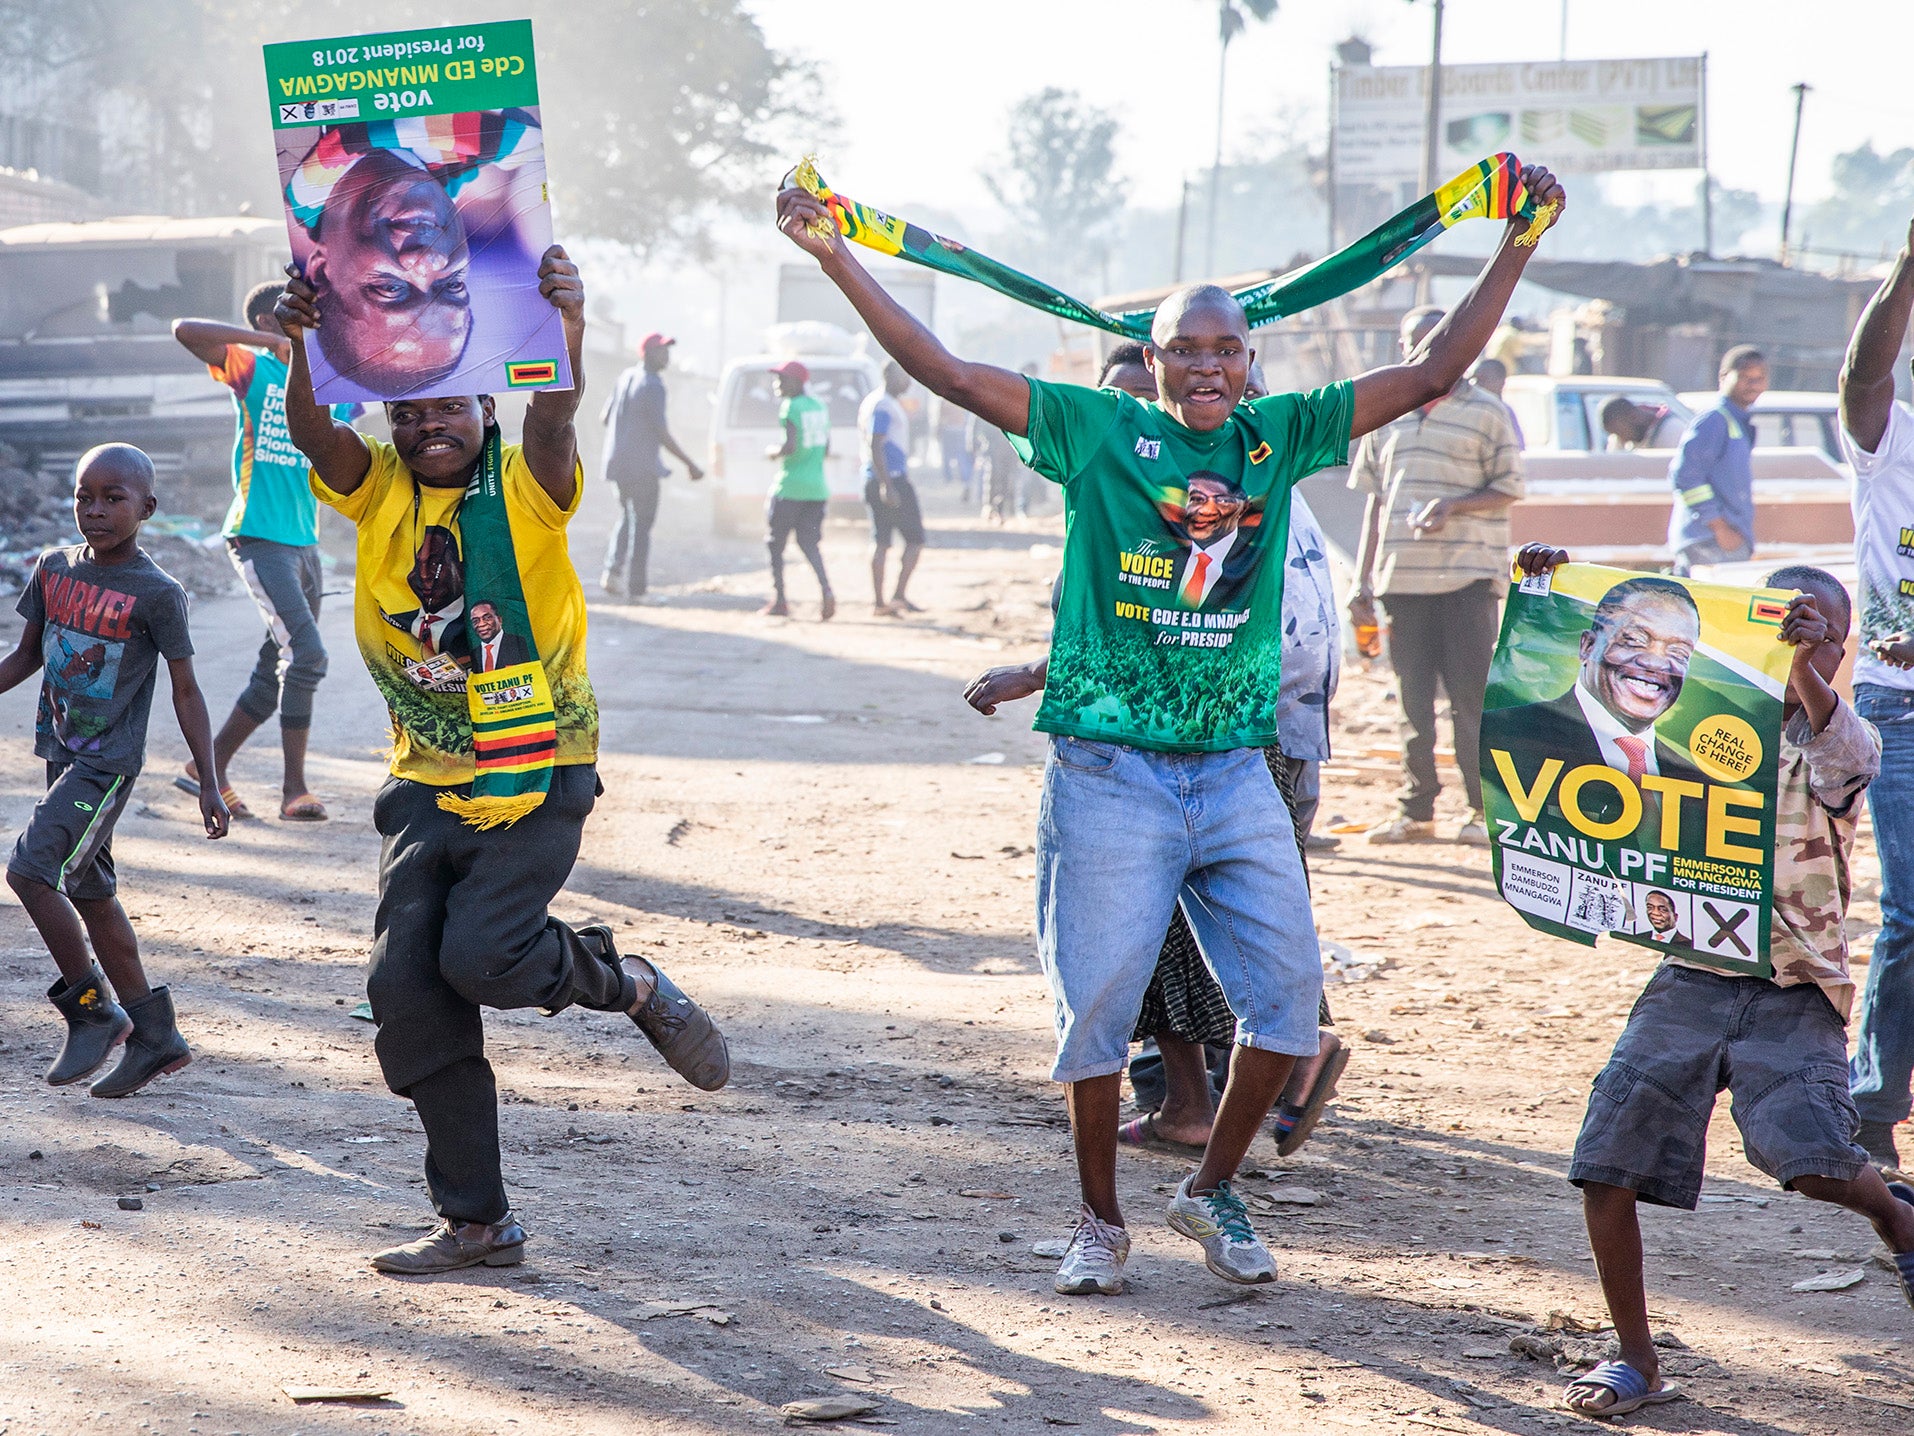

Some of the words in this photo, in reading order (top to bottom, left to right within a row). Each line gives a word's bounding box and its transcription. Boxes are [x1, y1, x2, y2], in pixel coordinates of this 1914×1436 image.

[364, 38, 452, 60] President
[457, 35, 485, 53] for
[313, 47, 358, 66] 2018
[481, 55, 525, 78] Cde
[279, 63, 438, 97] MNANGAGWA
[445, 60, 476, 81] ED
[1339, 67, 1408, 101] Timber
[1441, 65, 1514, 97] Boards
[1520, 62, 1590, 93] Center
[1598, 60, 1657, 97] (PVT)
[374, 89, 433, 112] vote
[255, 448, 297, 467] Since
[487, 471, 497, 497] UNITE,
[1134, 538, 1159, 556] The
[1119, 551, 1174, 579] VOICE
[1118, 572, 1128, 582] OF
[1128, 574, 1142, 586] THE
[1142, 576, 1170, 590] PEOPLE
[40, 568, 137, 639] MARVEL
[1115, 601, 1150, 622] VOTE
[1152, 608, 1179, 627] CDE
[1181, 611, 1202, 628] E.D
[1153, 630, 1180, 646] for
[386, 640, 406, 667] VOTE
[474, 682, 496, 694] VOTE
[496, 676, 520, 690] ZANU
[522, 674, 534, 684] PF
[1699, 733, 1753, 765] CHANGE
[1714, 727, 1745, 750] REAL
[1695, 743, 1708, 755] IS
[1709, 750, 1747, 774] HERE!
[1489, 748, 1764, 866] VOTE
[1495, 818, 1605, 870] ZANU
[1620, 847, 1668, 882] PF
[1511, 863, 1560, 884] EMMERSON
[1577, 872, 1608, 888] ZANU
[1673, 856, 1746, 878] EMMERSON
[1749, 869, 1763, 881] D.
[1673, 867, 1762, 890] MNANGAGWA
[1504, 882, 1562, 907] MNANGAGWA
[1511, 873, 1559, 894] DAMBUDZO
[1672, 876, 1696, 889] FOR
[1698, 881, 1762, 900] PRESIDENT
